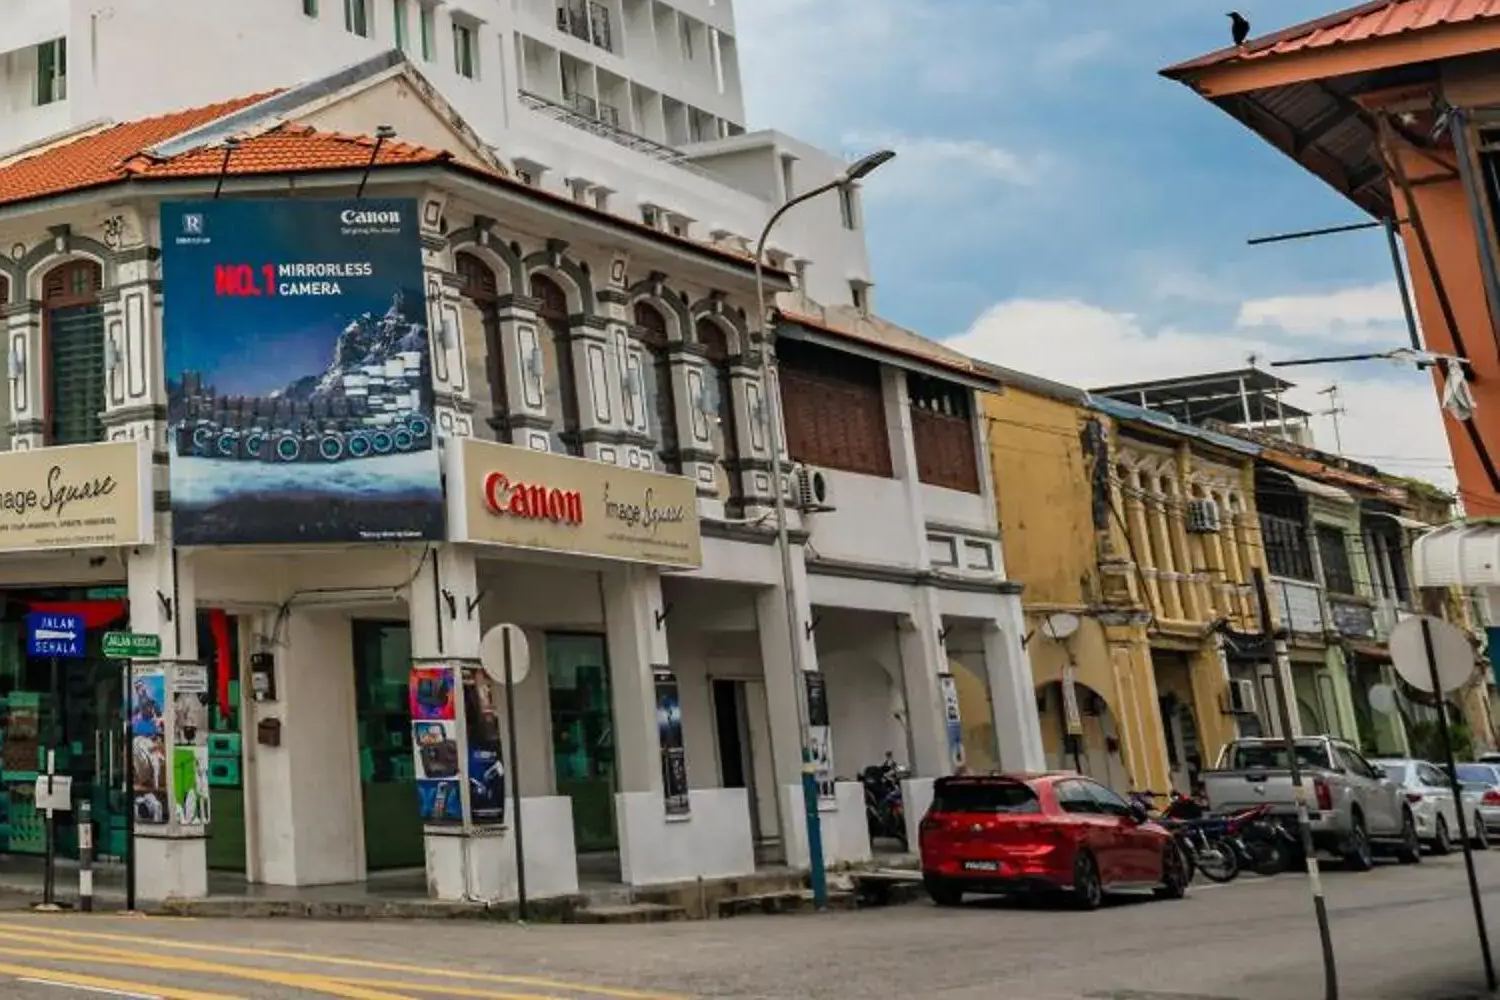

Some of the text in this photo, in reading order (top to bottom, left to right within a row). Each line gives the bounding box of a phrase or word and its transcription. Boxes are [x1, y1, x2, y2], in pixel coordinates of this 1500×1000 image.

[341, 209, 400, 225] Canon
[279, 262, 372, 278] MIRRORLESS
[279, 282, 341, 296] CAMERA
[40, 465, 117, 516] Square
[484, 471, 584, 527] Canon
[41, 616, 75, 629] JALAN
[35, 641, 77, 653] SEHALA
